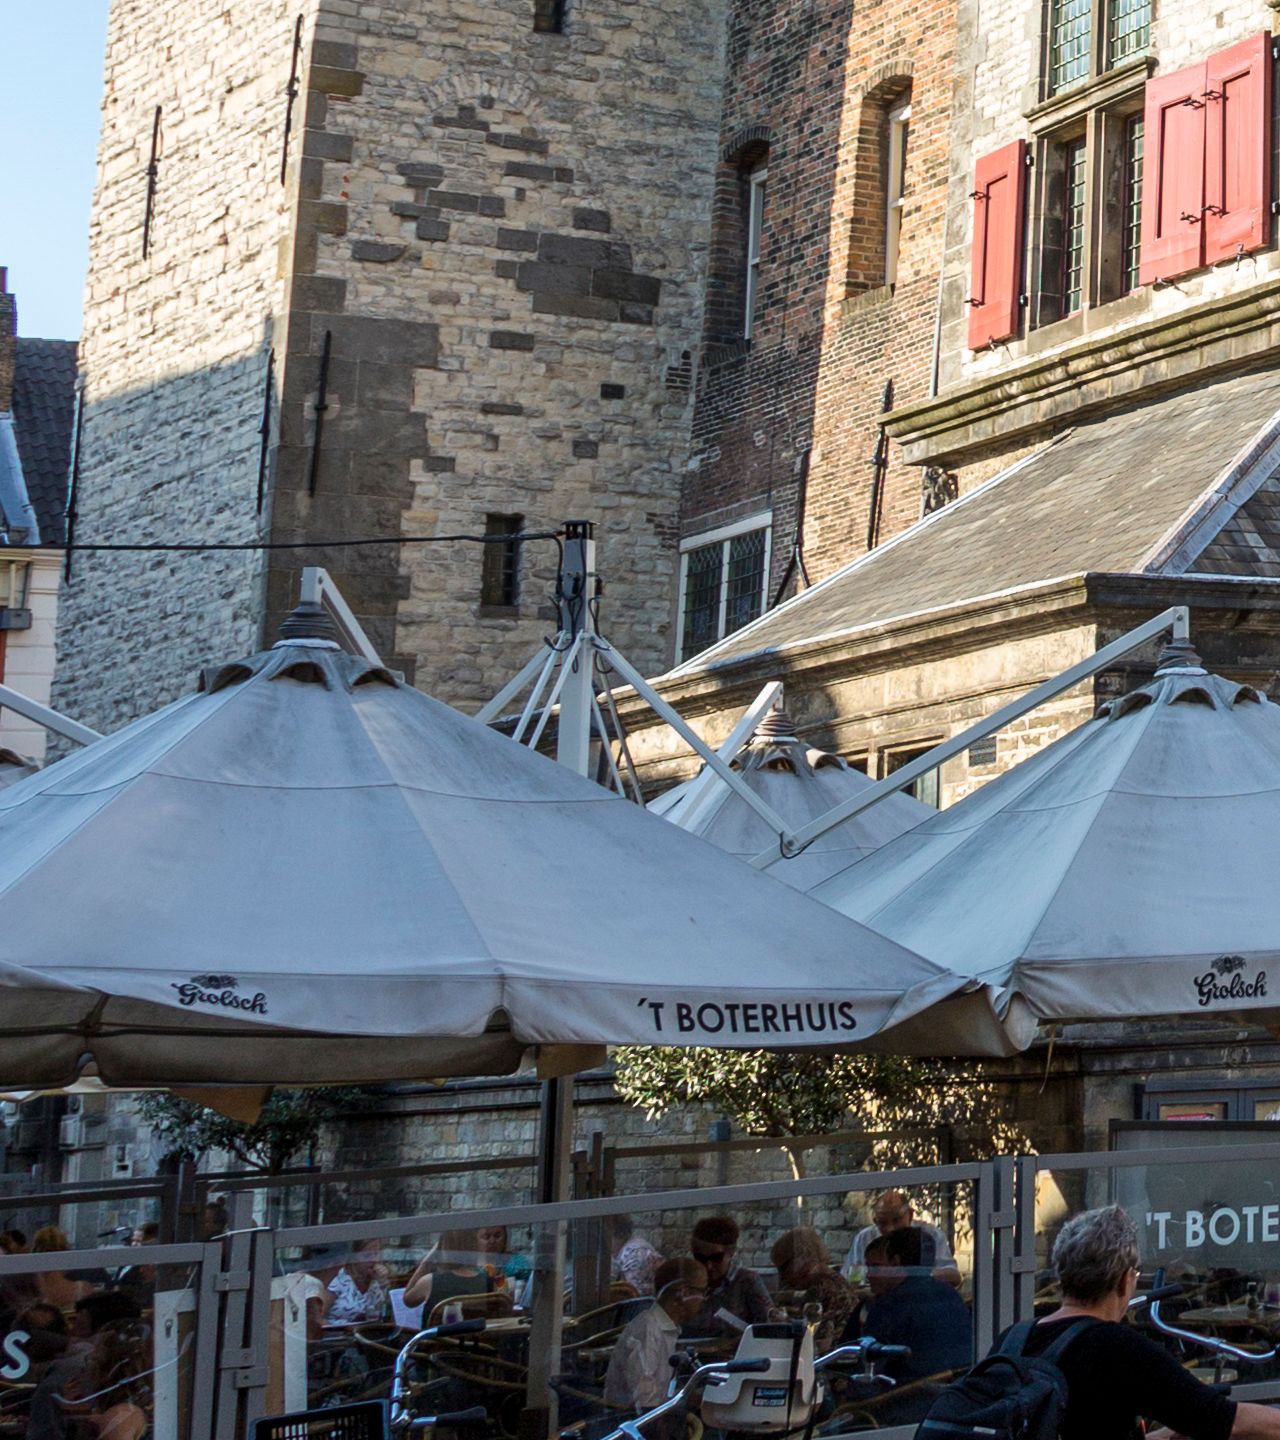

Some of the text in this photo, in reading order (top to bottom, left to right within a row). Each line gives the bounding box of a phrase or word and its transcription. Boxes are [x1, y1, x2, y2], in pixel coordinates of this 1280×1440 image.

[170, 983, 269, 1014] Grolsch
[1193, 971, 1268, 1006] Grolsch
[676, 1001, 857, 1033] BOTERHUIS
[1146, 1211, 1171, 1249] 'T
